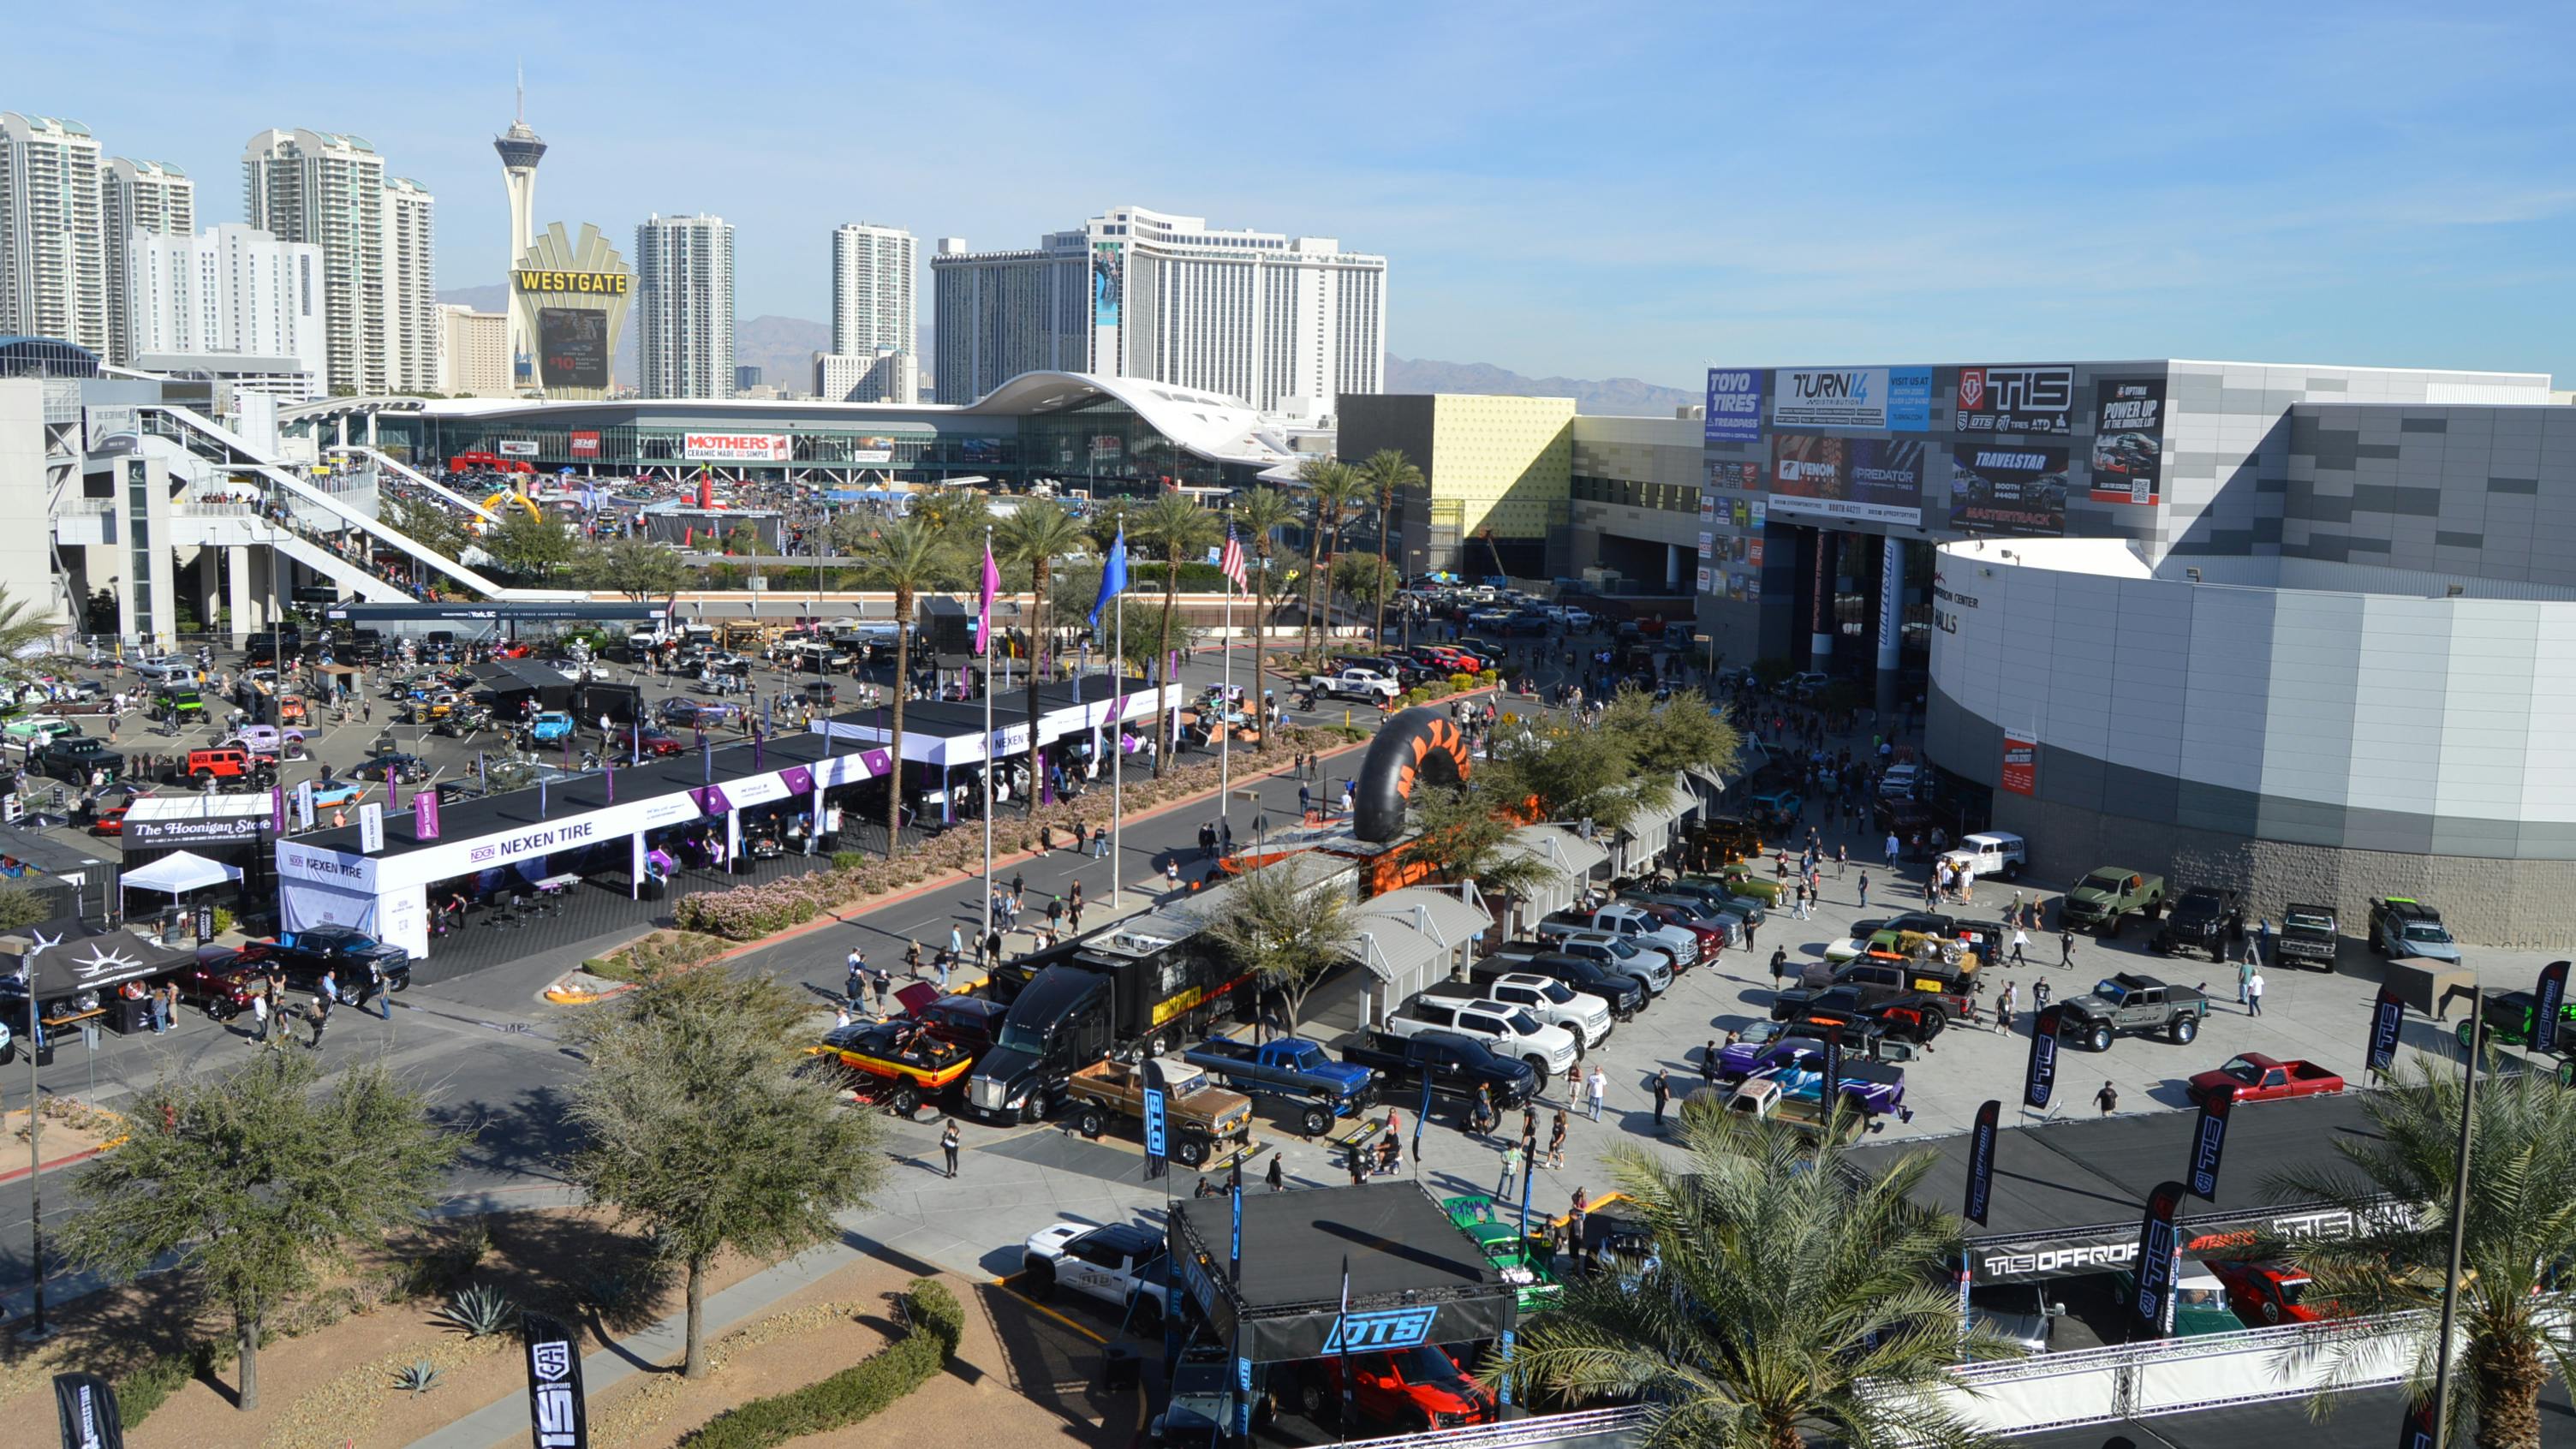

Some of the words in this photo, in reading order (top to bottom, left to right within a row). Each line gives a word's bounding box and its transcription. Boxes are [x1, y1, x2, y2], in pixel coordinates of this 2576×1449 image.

[522, 271, 626, 292] WESTGATE
[549, 355, 575, 370] $10
[1711, 373, 1750, 391] TOYO
[1891, 377, 1908, 385] VISIT
[1910, 377, 1919, 385] US
[1986, 367, 2073, 411] TIS
[2125, 386, 2147, 396] OPTIMA
[1713, 393, 1757, 412] TIRES
[2104, 401, 2141, 420] POWER
[2142, 400, 2157, 417] UP
[1714, 417, 1758, 428] TREADPASS
[1970, 416, 1994, 427] DTS
[2031, 419, 2050, 431] ATD
[2103, 420, 2110, 429] AT
[2111, 419, 2120, 428] THE
[2144, 417, 2156, 427] LOT
[573, 438, 597, 448] SEMA
[688, 436, 768, 450] MOTHERS
[746, 450, 768, 458] SIMPLE
[1975, 452, 2047, 470] TRAVELSTAR
[1801, 462, 1834, 476] VENOM
[1857, 468, 1913, 482] PREDATOR
[1828, 504, 1845, 512] BOOTH
[1966, 507, 2051, 526] MASTERTRACK
[1879, 546, 1893, 645] TRAVELSTAR
[1954, 593, 1978, 609] CENTER
[995, 736, 1024, 750] NEXEN
[134, 824, 162, 836] The
[164, 821, 234, 835] Hoonigan
[500, 831, 555, 856] NEXEN
[558, 822, 593, 842] TIRE
[307, 857, 338, 873] NEXEN
[340, 864, 362, 879] TIRE
[2542, 980, 2555, 1019] OFFROAD
[2377, 1003, 2398, 1048] TIS
[2034, 1034, 2054, 1082] TIS
[1147, 1091, 1163, 1153] DTS
[1977, 1124, 1988, 1177] OFFROAD
[2198, 1115, 2222, 1170] TIS
[1972, 1178, 1987, 1218] TIS
[1985, 1254, 2036, 1276] TIS
[2037, 1242, 2139, 1271] OFFROA
[2142, 1219, 2172, 1287] TIS
[2167, 1292, 2176, 1333] #TEAMTIS
[1327, 1311, 1433, 1351] DTS
[80, 1385, 91, 1405] TIRES
[82, 1405, 94, 1440] HERCULES
